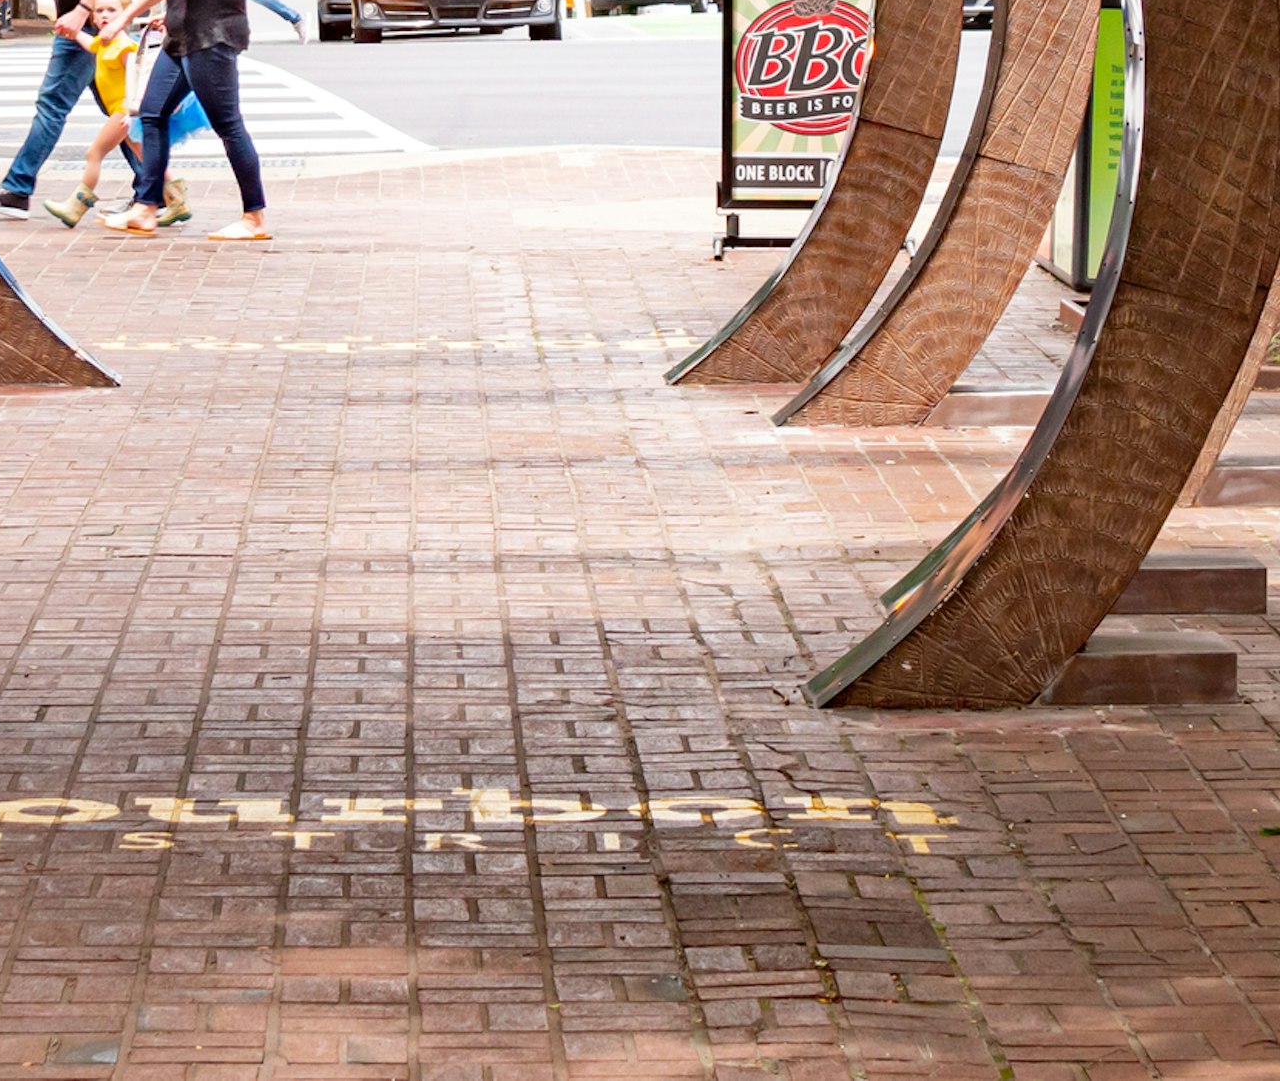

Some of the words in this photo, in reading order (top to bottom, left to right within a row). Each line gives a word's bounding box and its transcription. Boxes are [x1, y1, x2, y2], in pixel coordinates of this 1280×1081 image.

[747, 21, 867, 93] BBC
[751, 101, 798, 115] BEER
[807, 99, 824, 111] IS
[832, 96, 853, 108] FO
[735, 165, 765, 181] ONE
[769, 164, 815, 181] BLOCK
